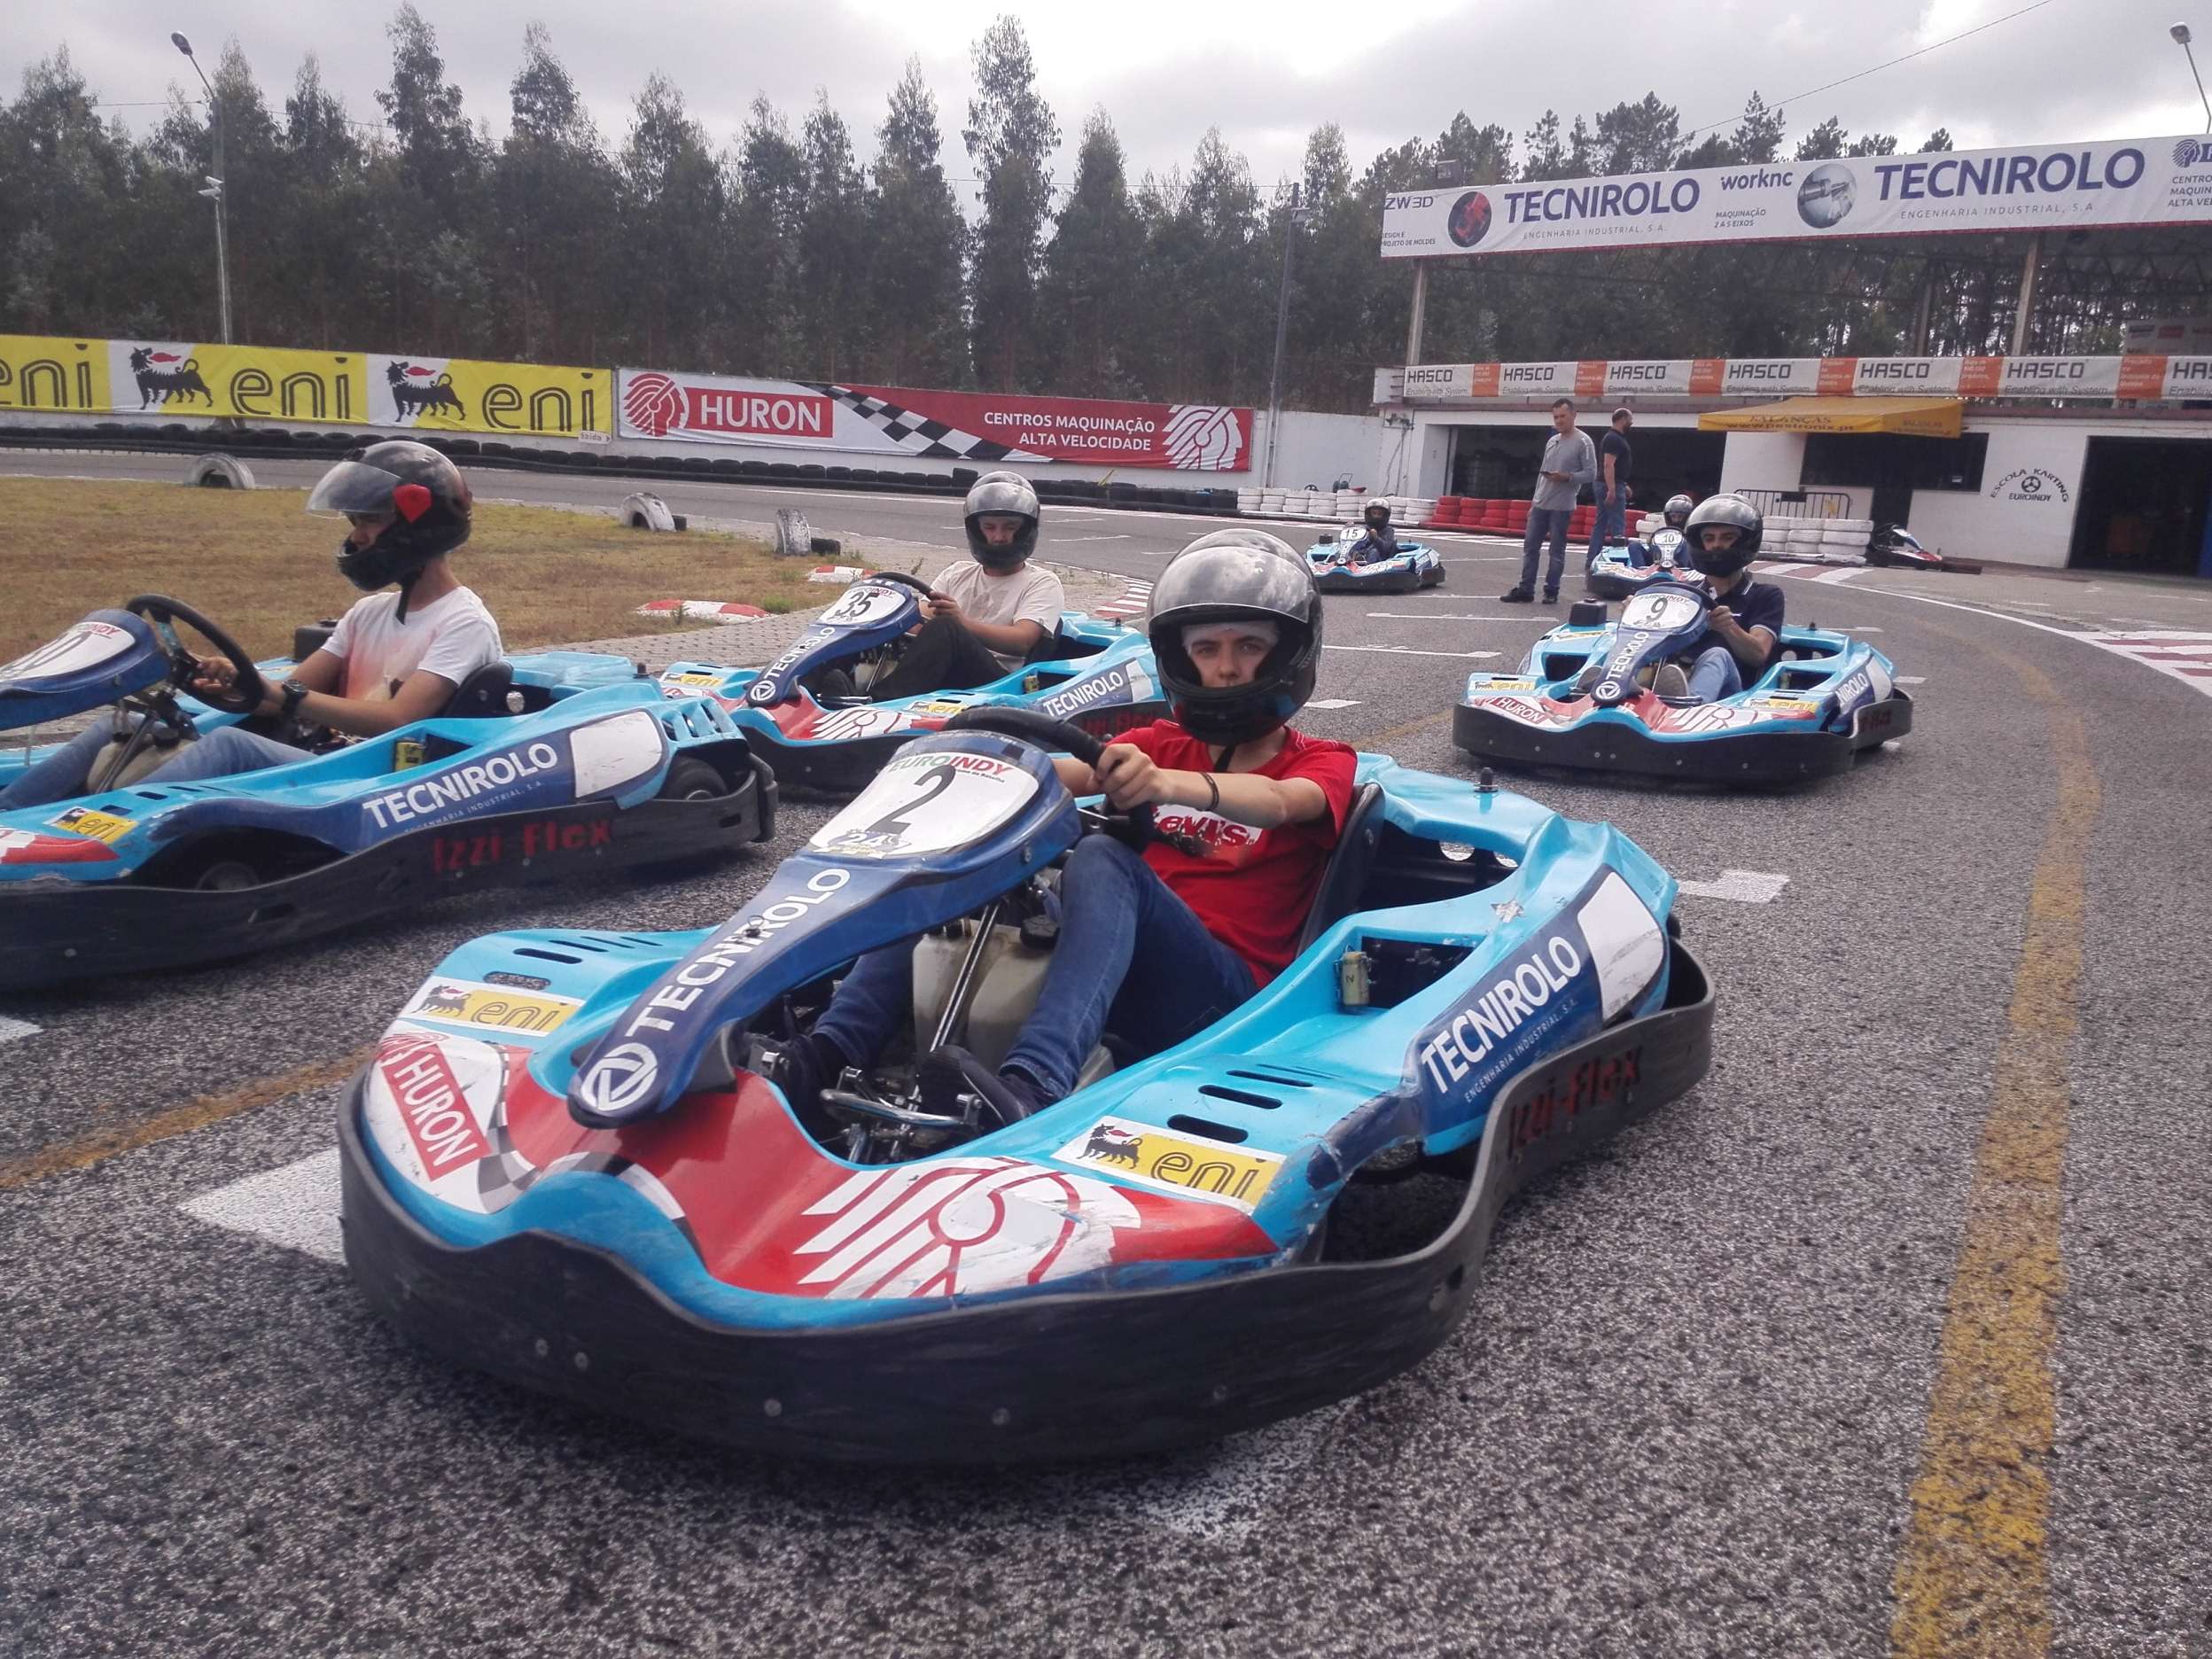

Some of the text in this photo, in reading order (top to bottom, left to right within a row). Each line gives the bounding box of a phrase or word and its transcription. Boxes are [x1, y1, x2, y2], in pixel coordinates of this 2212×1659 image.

[1721, 168, 1794, 191] worknc
[1874, 148, 2146, 200] TECNIROLO
[1504, 177, 1700, 223] TECNIROLO
[2168, 199, 2193, 207] ALTA
[1900, 208, 1978, 220] ENGENHARIA
[1523, 229, 1580, 240] ENGENHARIA
[1407, 369, 1453, 383] HASCO
[1504, 367, 1554, 381] HASCO
[1610, 365, 1666, 379] HASCO
[1729, 364, 1791, 378] HASCO
[1861, 363, 1930, 378] HASCO
[2007, 362, 2084, 378] HASCO
[230, 357, 350, 420] eni
[482, 372, 595, 432] eni
[2072, 386, 2107, 395] System
[701, 394, 821, 432] HURON
[984, 412, 1156, 435] CENTROS MAQUINAÇÃO
[1019, 432, 1151, 451] ALTA VELOCIDADE
[1990, 468, 2069, 502] ESCOLA KARTING
[2008, 493, 2052, 502] EUROINDY
[1345, 529, 1358, 539] 15
[834, 591, 881, 618] 35
[1647, 597, 1668, 624] 9
[1043, 671, 1124, 717] TECNIROLO
[1498, 698, 1545, 723] HURON
[887, 755, 1014, 775] EUROINDY
[362, 743, 558, 829] TECNIROLO
[865, 764, 957, 835] 2
[1158, 815, 1250, 847] evi's
[624, 868, 851, 1037] TECNIROLO
[471, 1001, 567, 1031] eni
[1421, 937, 1581, 1094] TECNIROLO
[1464, 1053, 1515, 1103] ENGENHARIA
[393, 1054, 478, 1167] HURON
[1150, 1152, 1266, 1199] eni
